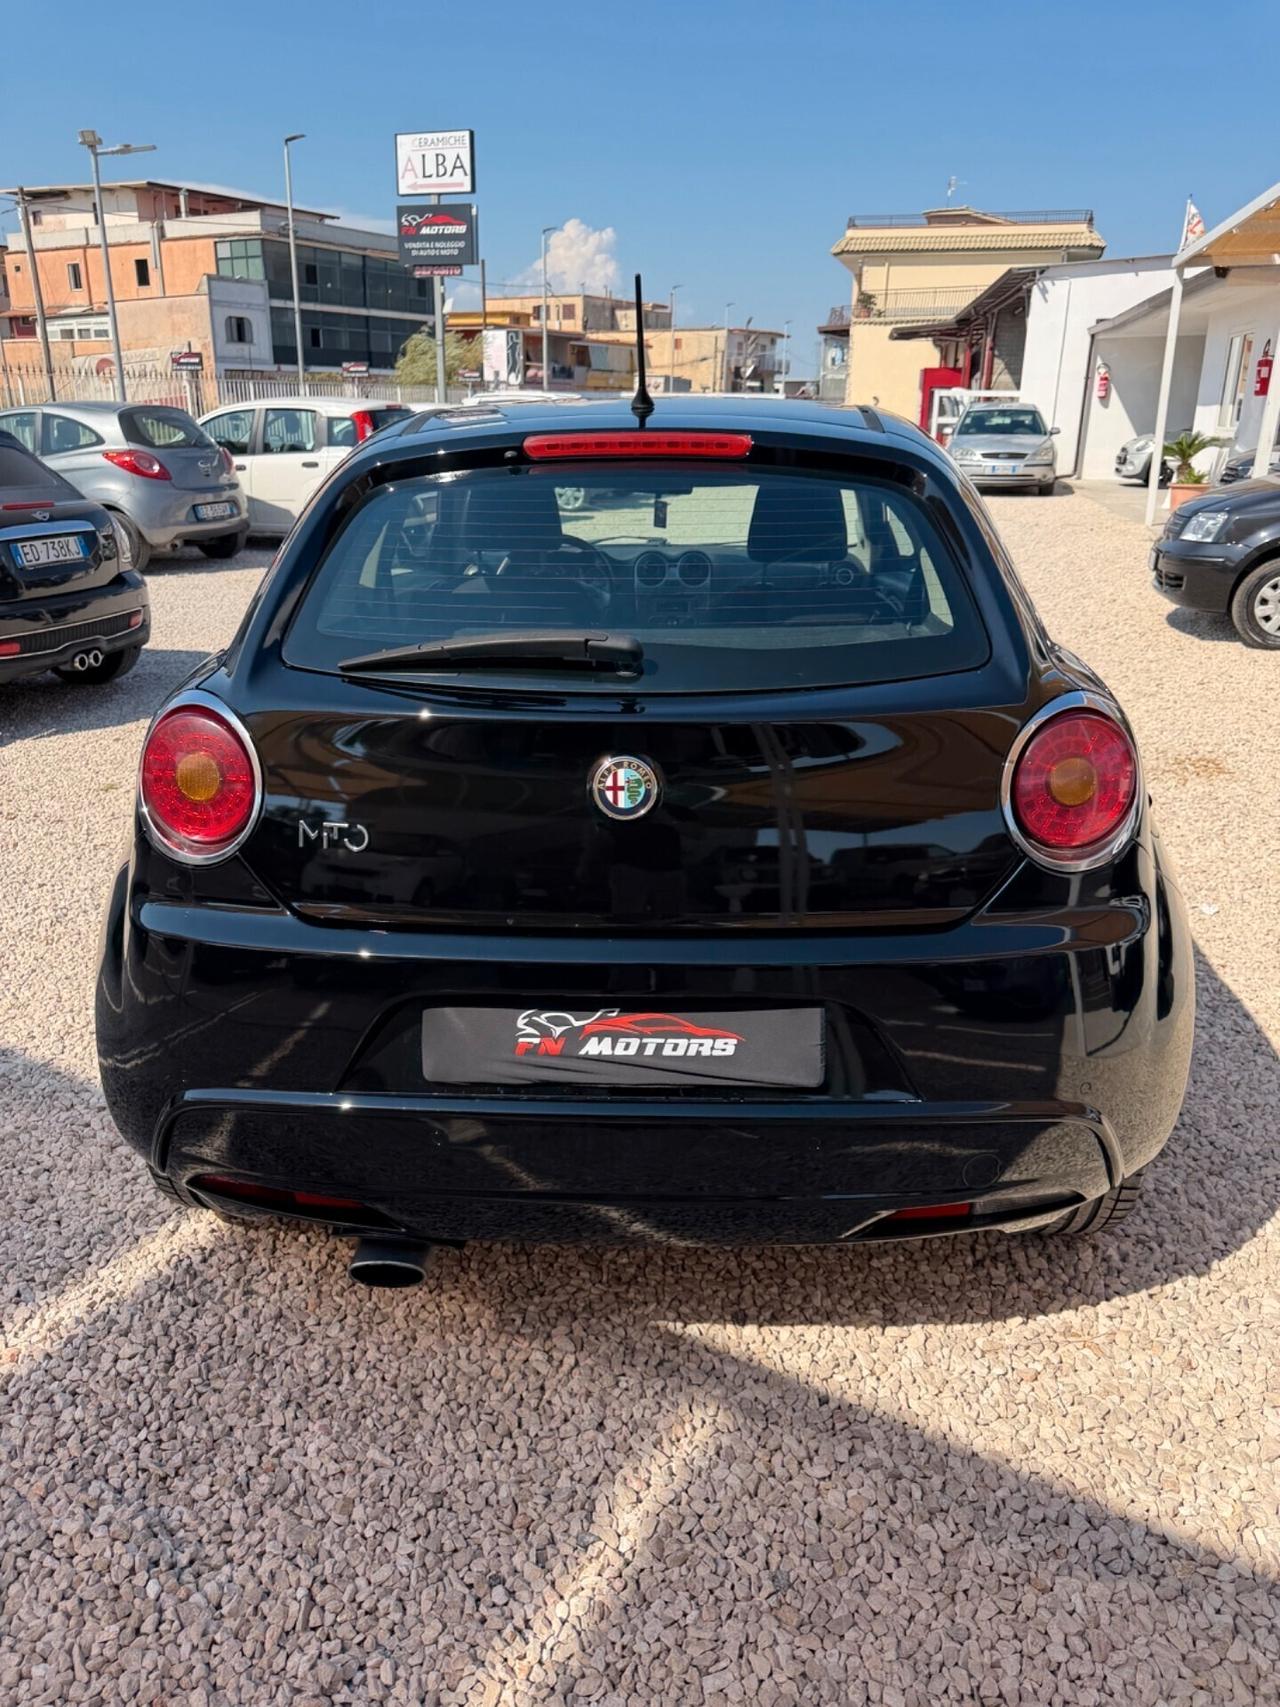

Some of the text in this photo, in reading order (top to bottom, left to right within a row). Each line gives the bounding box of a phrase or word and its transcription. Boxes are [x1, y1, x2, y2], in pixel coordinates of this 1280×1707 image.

[411, 134, 467, 148] CERAMICHE
[400, 152, 469, 179] ALBA
[419, 224, 468, 235] MOTORS
[435, 240, 466, 248] NOLEGGIO
[20, 539, 81, 563] ED 738KJ
[597, 761, 652, 791] ALFA ROMEO
[514, 1037, 738, 1057] FN MOTORS
